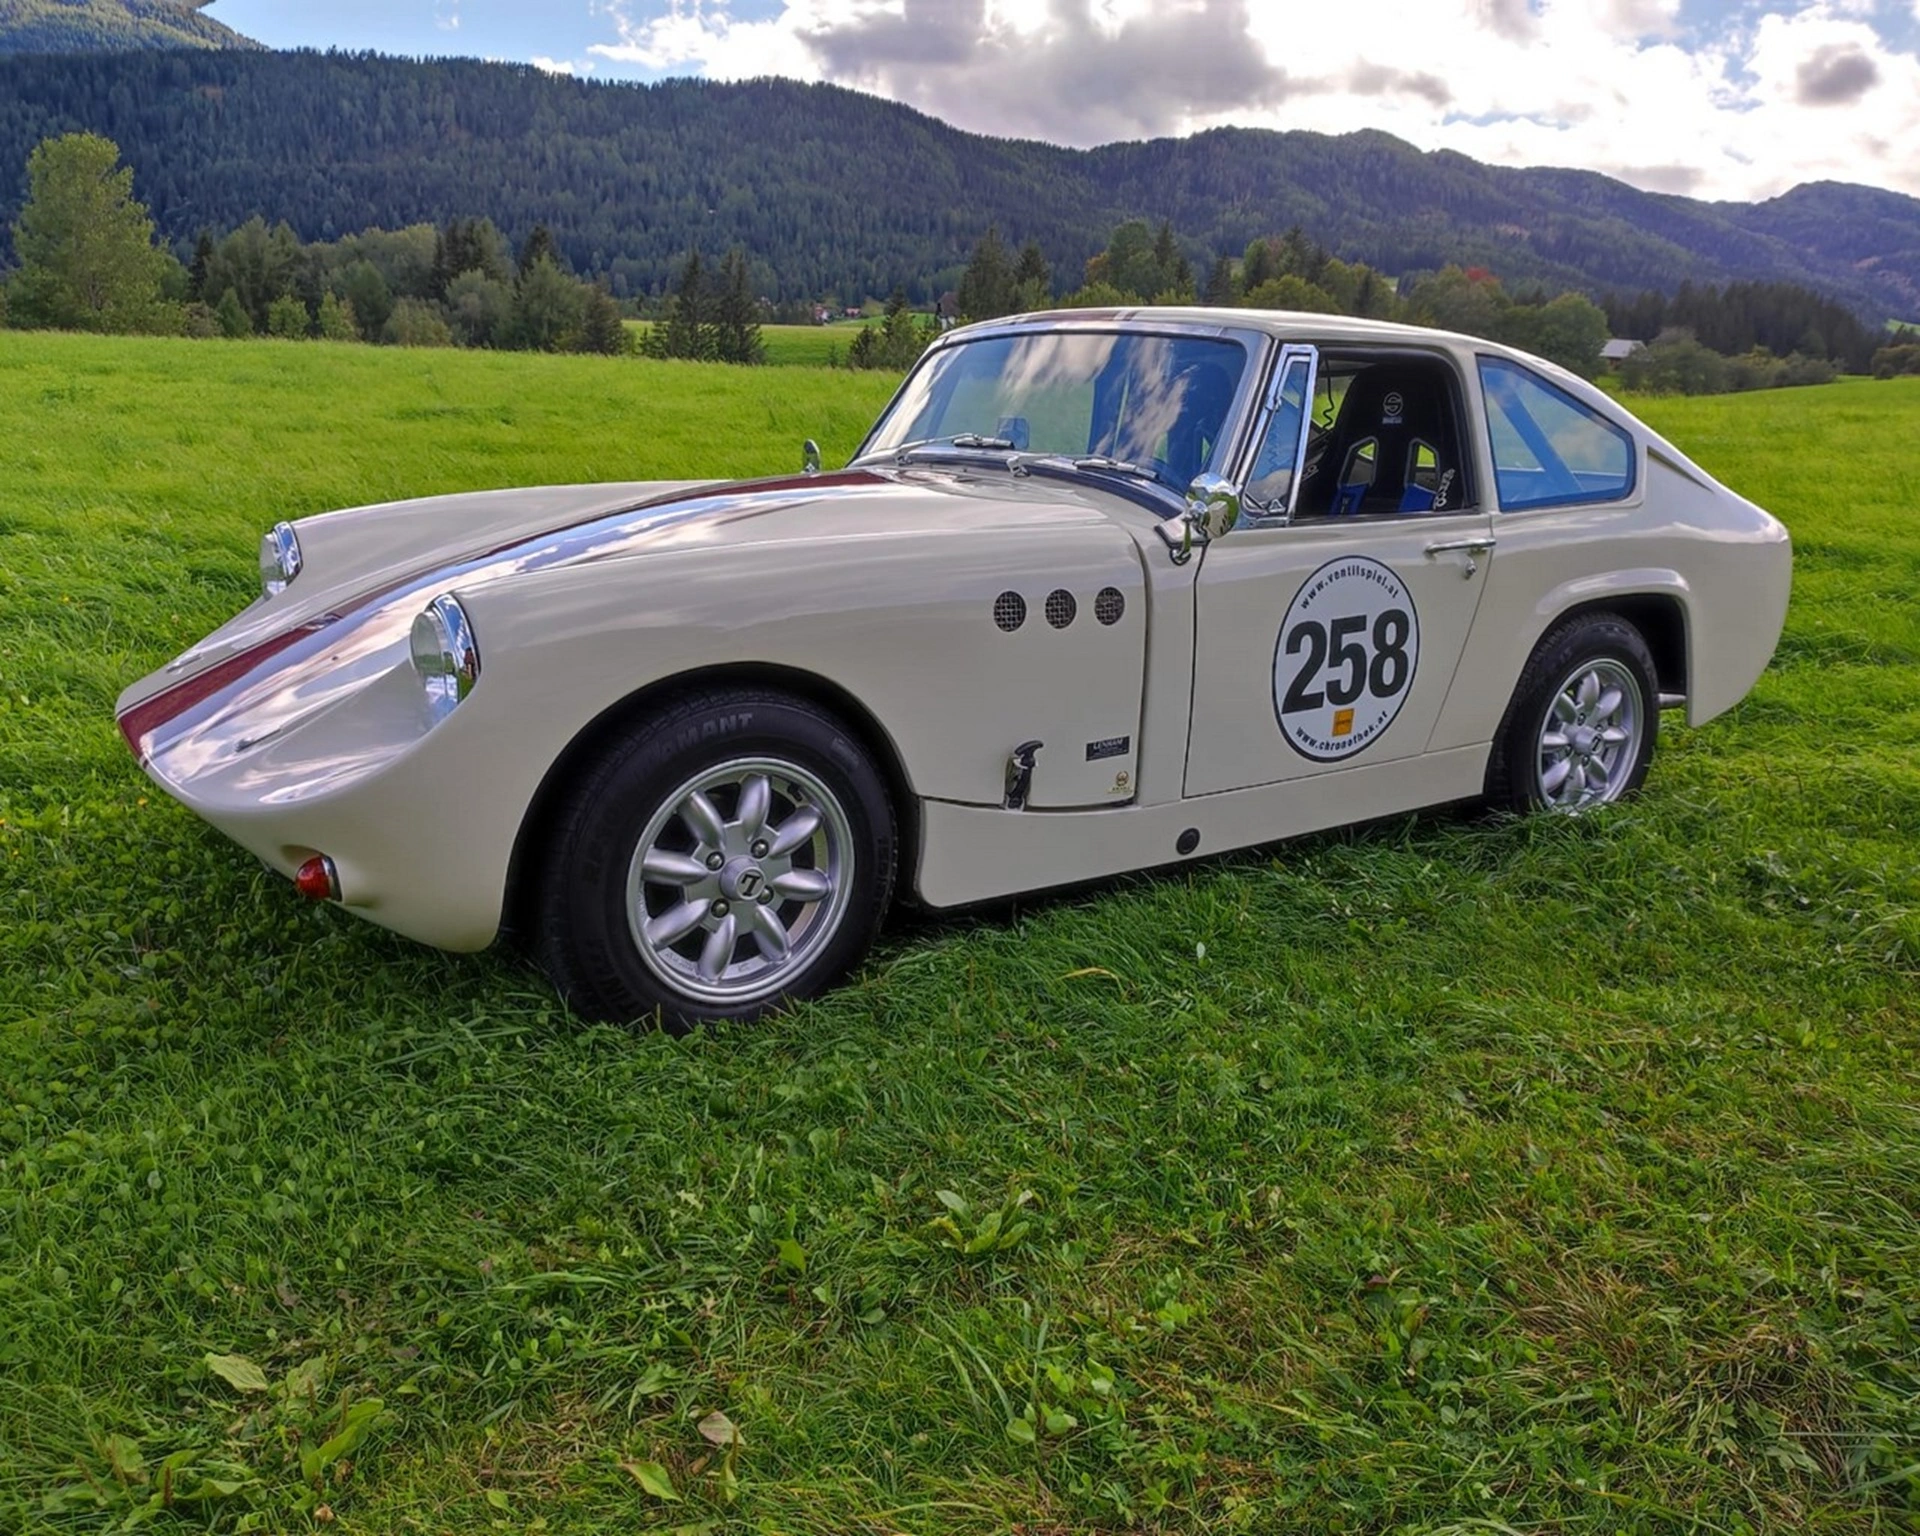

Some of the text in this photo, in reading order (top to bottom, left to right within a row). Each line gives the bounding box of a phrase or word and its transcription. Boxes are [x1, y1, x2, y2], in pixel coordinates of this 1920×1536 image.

[1300, 564, 1399, 609] www.ventilspiel.at
[1281, 608, 1410, 715] 258
[1295, 710, 1388, 751] www.chronothek.at
